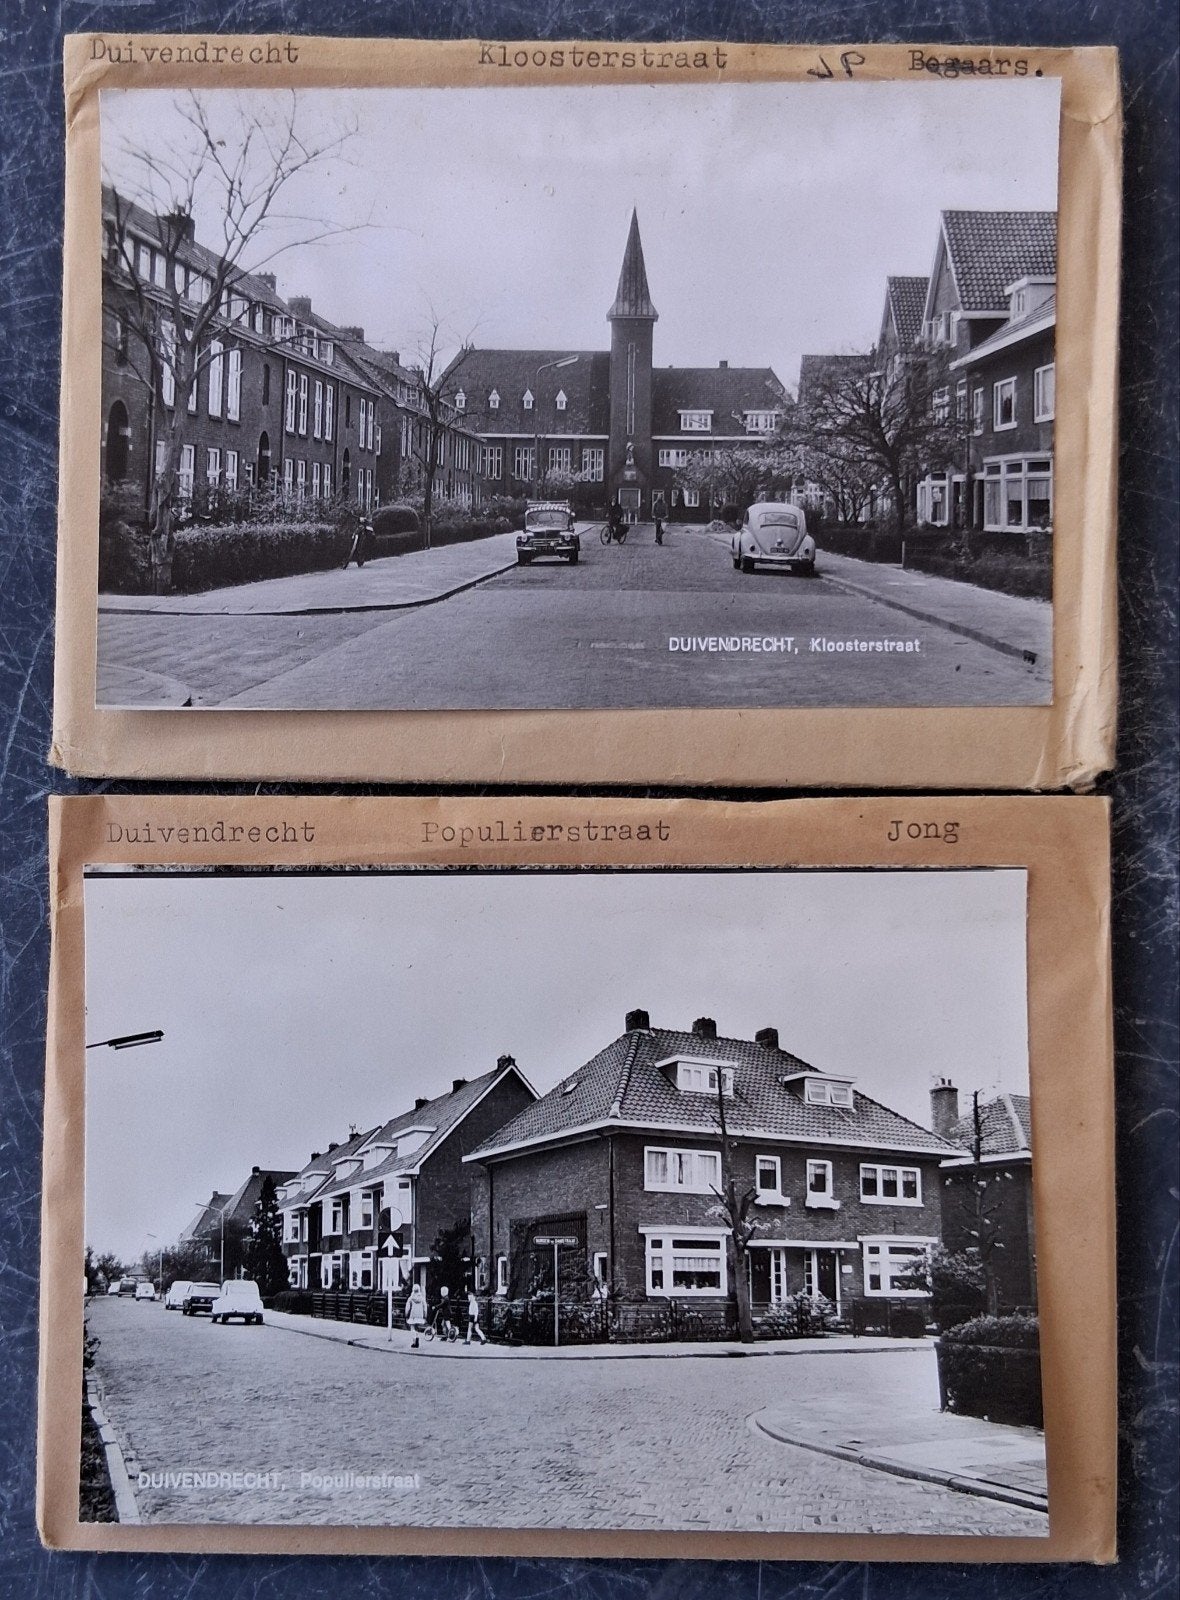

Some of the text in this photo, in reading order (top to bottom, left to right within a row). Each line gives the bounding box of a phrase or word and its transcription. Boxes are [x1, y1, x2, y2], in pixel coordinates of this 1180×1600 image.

[89, 39, 727, 69] Duivendrecht Kloosterstraat
[669, 637, 921, 654] DUIVENDRECHT, Kloosterstraat
[106, 820, 960, 847] Duivendrecht Populierstraat Jong
[138, 1472, 420, 1491] DUIVENDRECHT, Populierstraat
